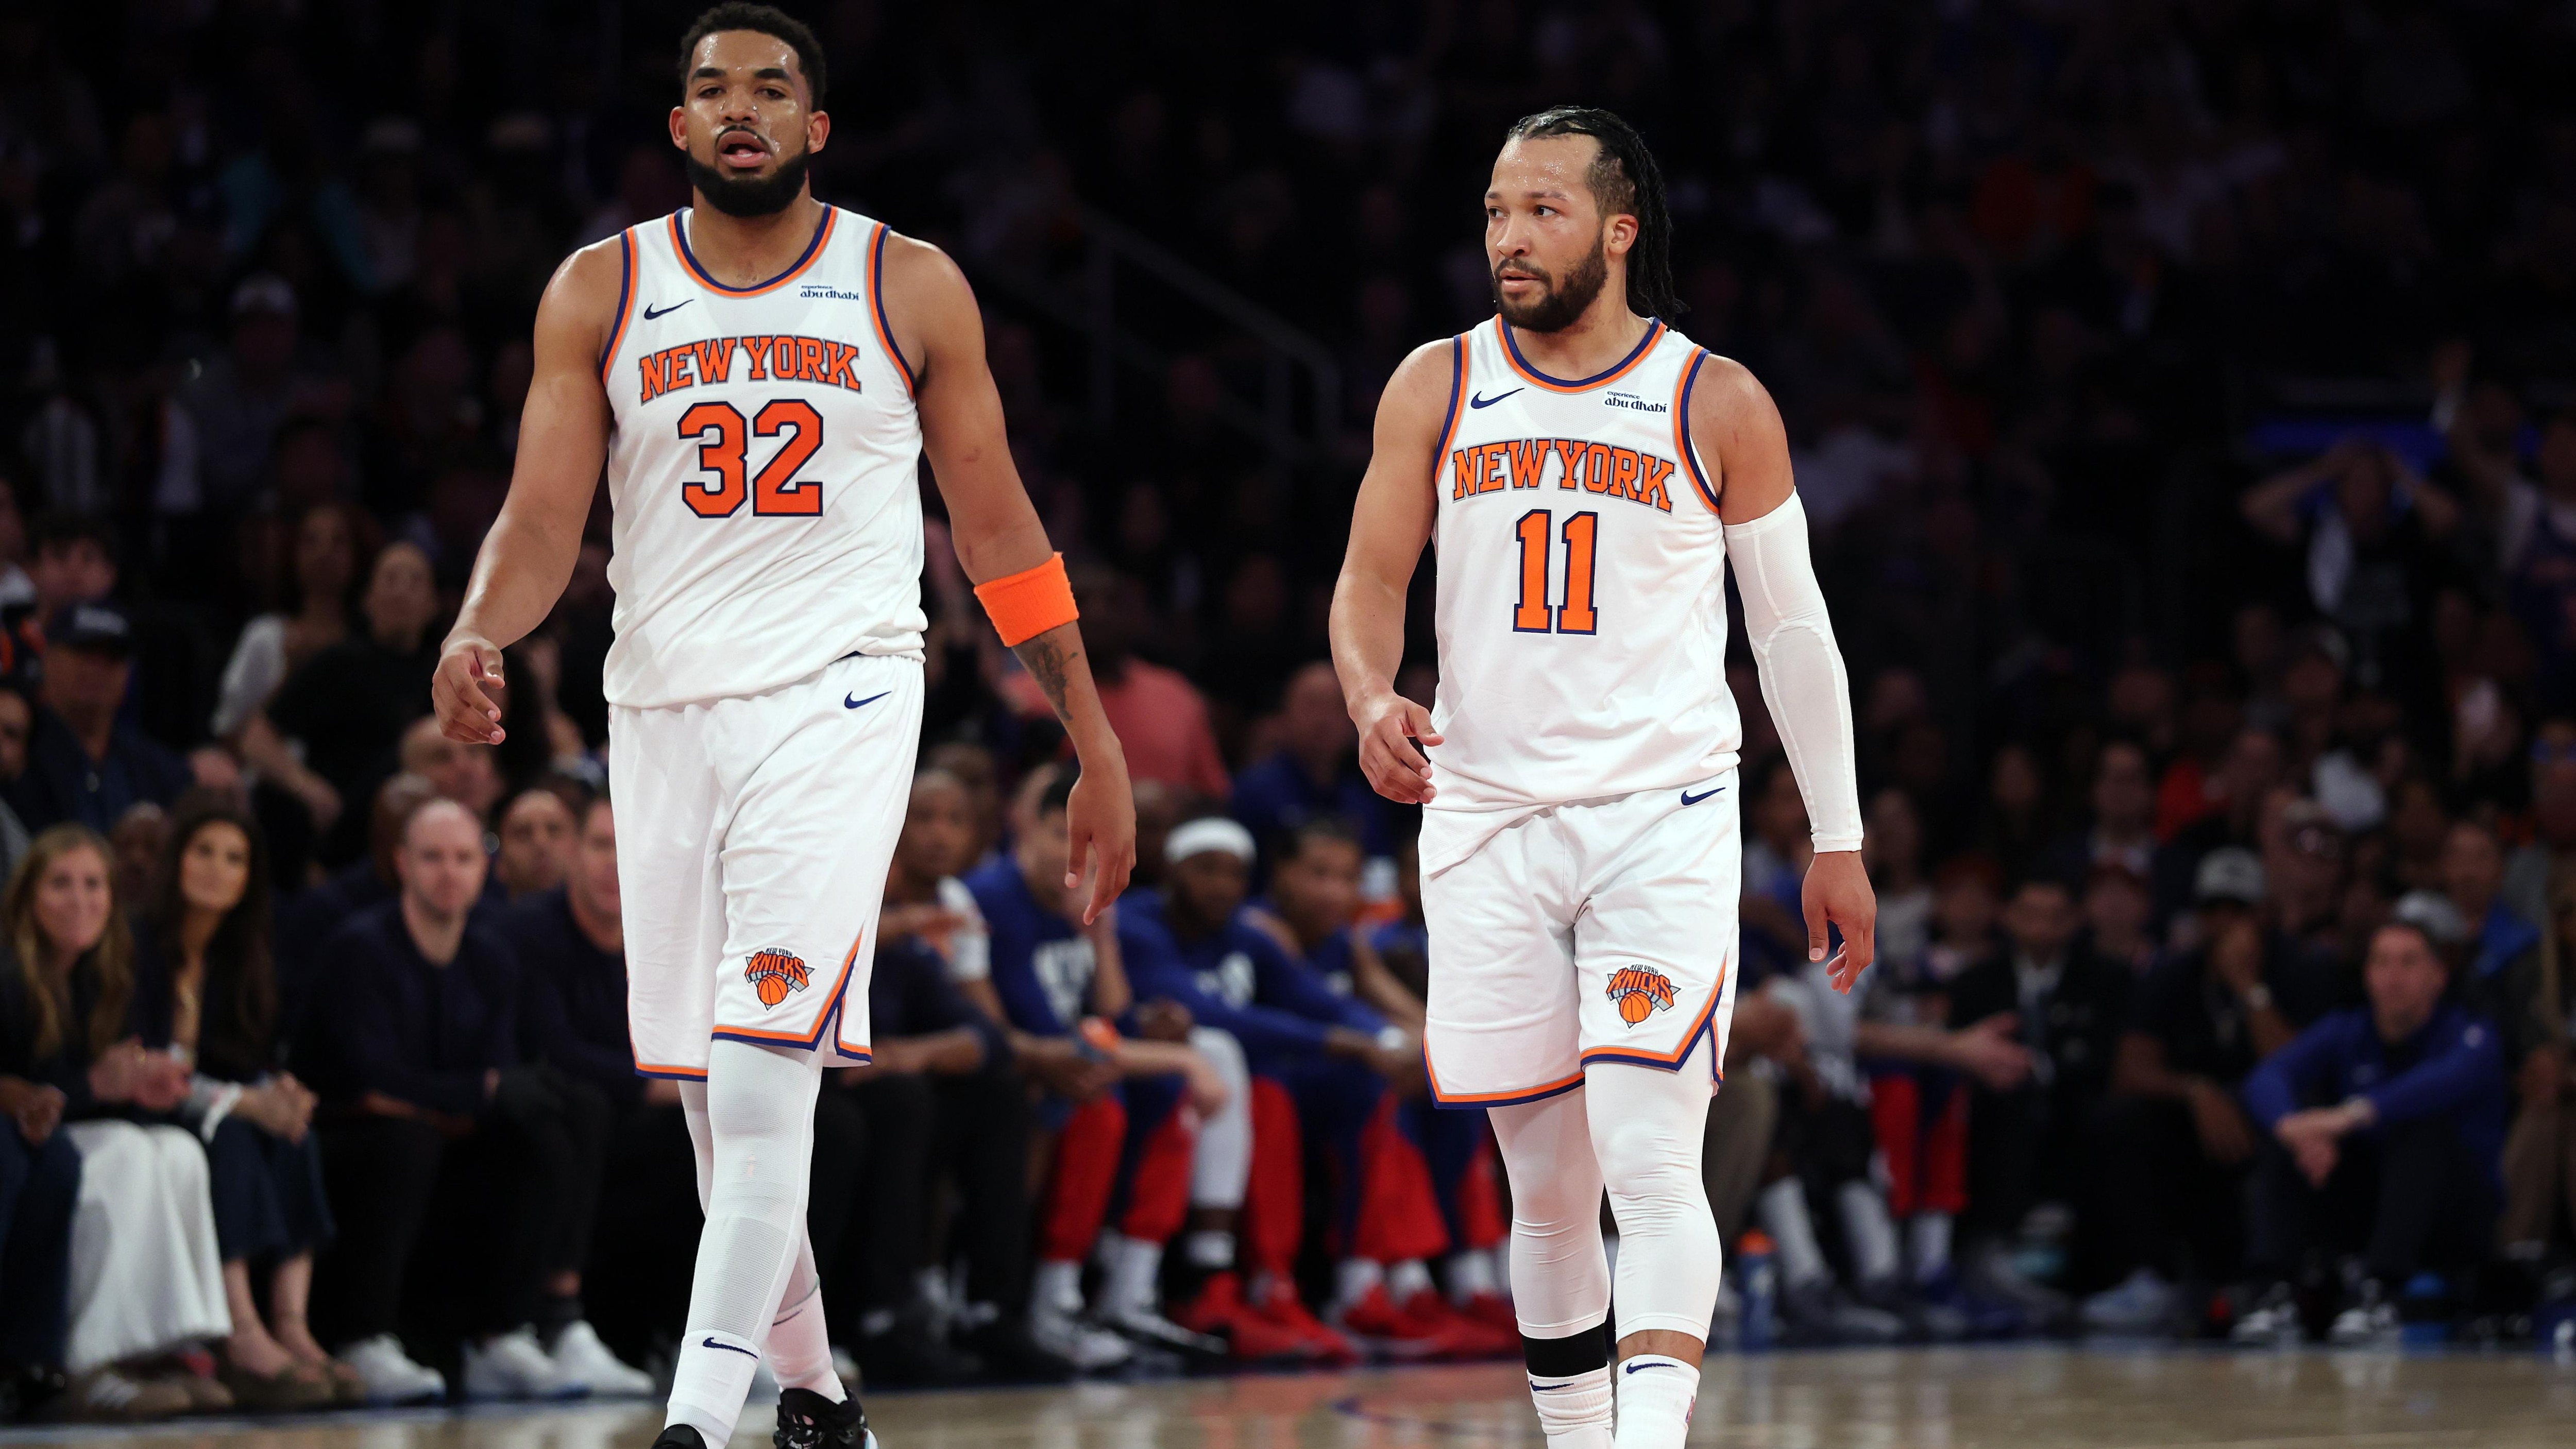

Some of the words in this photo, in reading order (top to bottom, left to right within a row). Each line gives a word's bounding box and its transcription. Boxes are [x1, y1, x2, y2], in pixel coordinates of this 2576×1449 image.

[825, 291, 859, 300] dhabi
[639, 336, 737, 406] NEW
[740, 334, 862, 395] YORK
[1605, 397, 1629, 408] abu
[1631, 401, 1667, 413] dhabi
[1607, 391, 1640, 399] experience
[677, 399, 823, 518] 32
[1452, 437, 1551, 503] NEW
[1553, 437, 1675, 515] YORK
[1513, 509, 1598, 635] 11
[745, 950, 809, 988] KNICKS
[778, 948, 793, 957] YORK
[1644, 965, 1658, 976] YORK
[1606, 967, 1674, 1007] KNICKS
